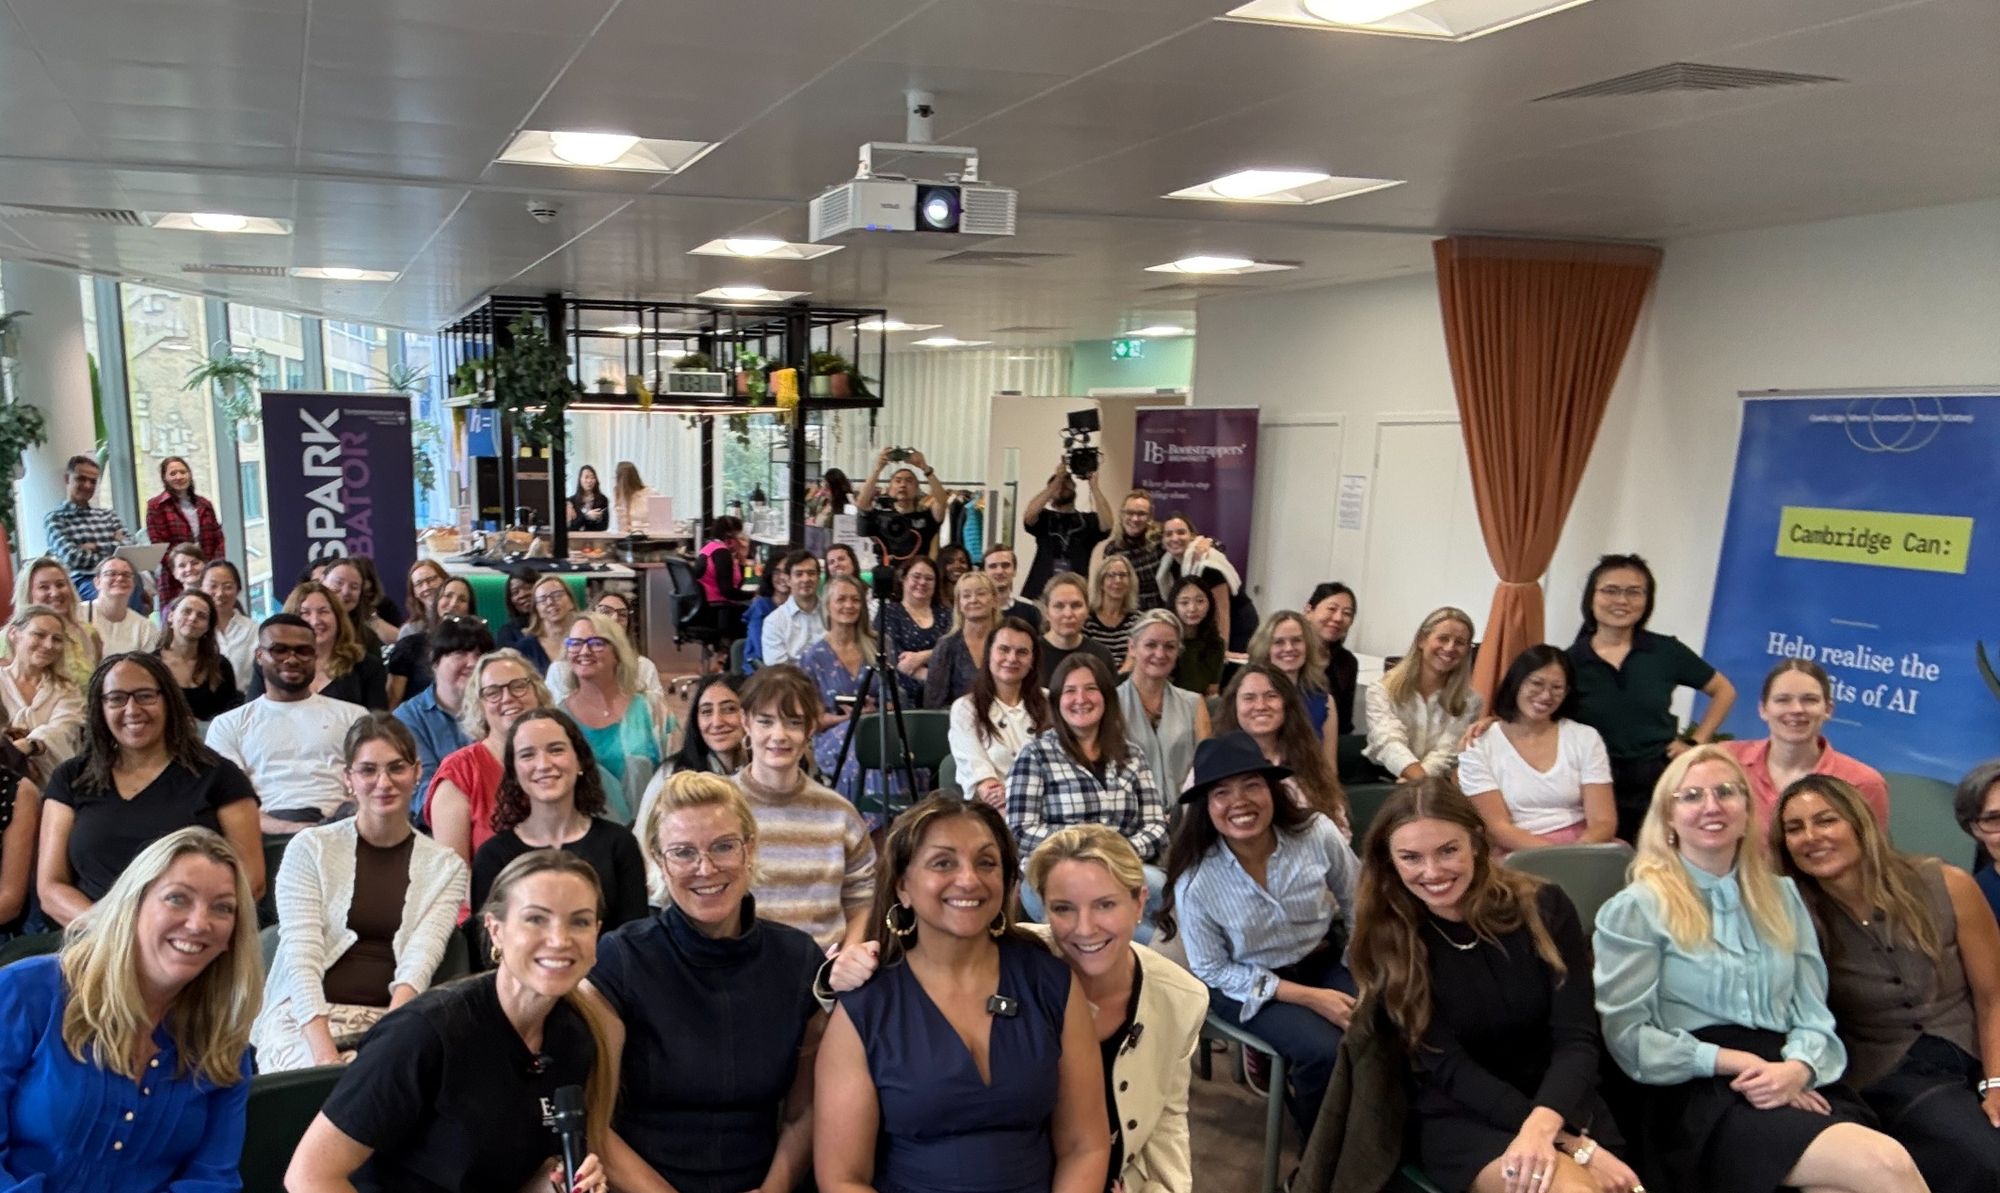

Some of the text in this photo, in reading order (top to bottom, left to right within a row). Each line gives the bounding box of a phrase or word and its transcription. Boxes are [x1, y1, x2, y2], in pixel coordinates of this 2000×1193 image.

[299, 408, 348, 563] SPARK
[341, 432, 374, 559] BATOR
[1790, 523, 1952, 556] Cambridge Can:
[1766, 631, 1940, 682] Help realise the
[1861, 683, 1889, 708] of
[1887, 687, 1920, 715] AI
